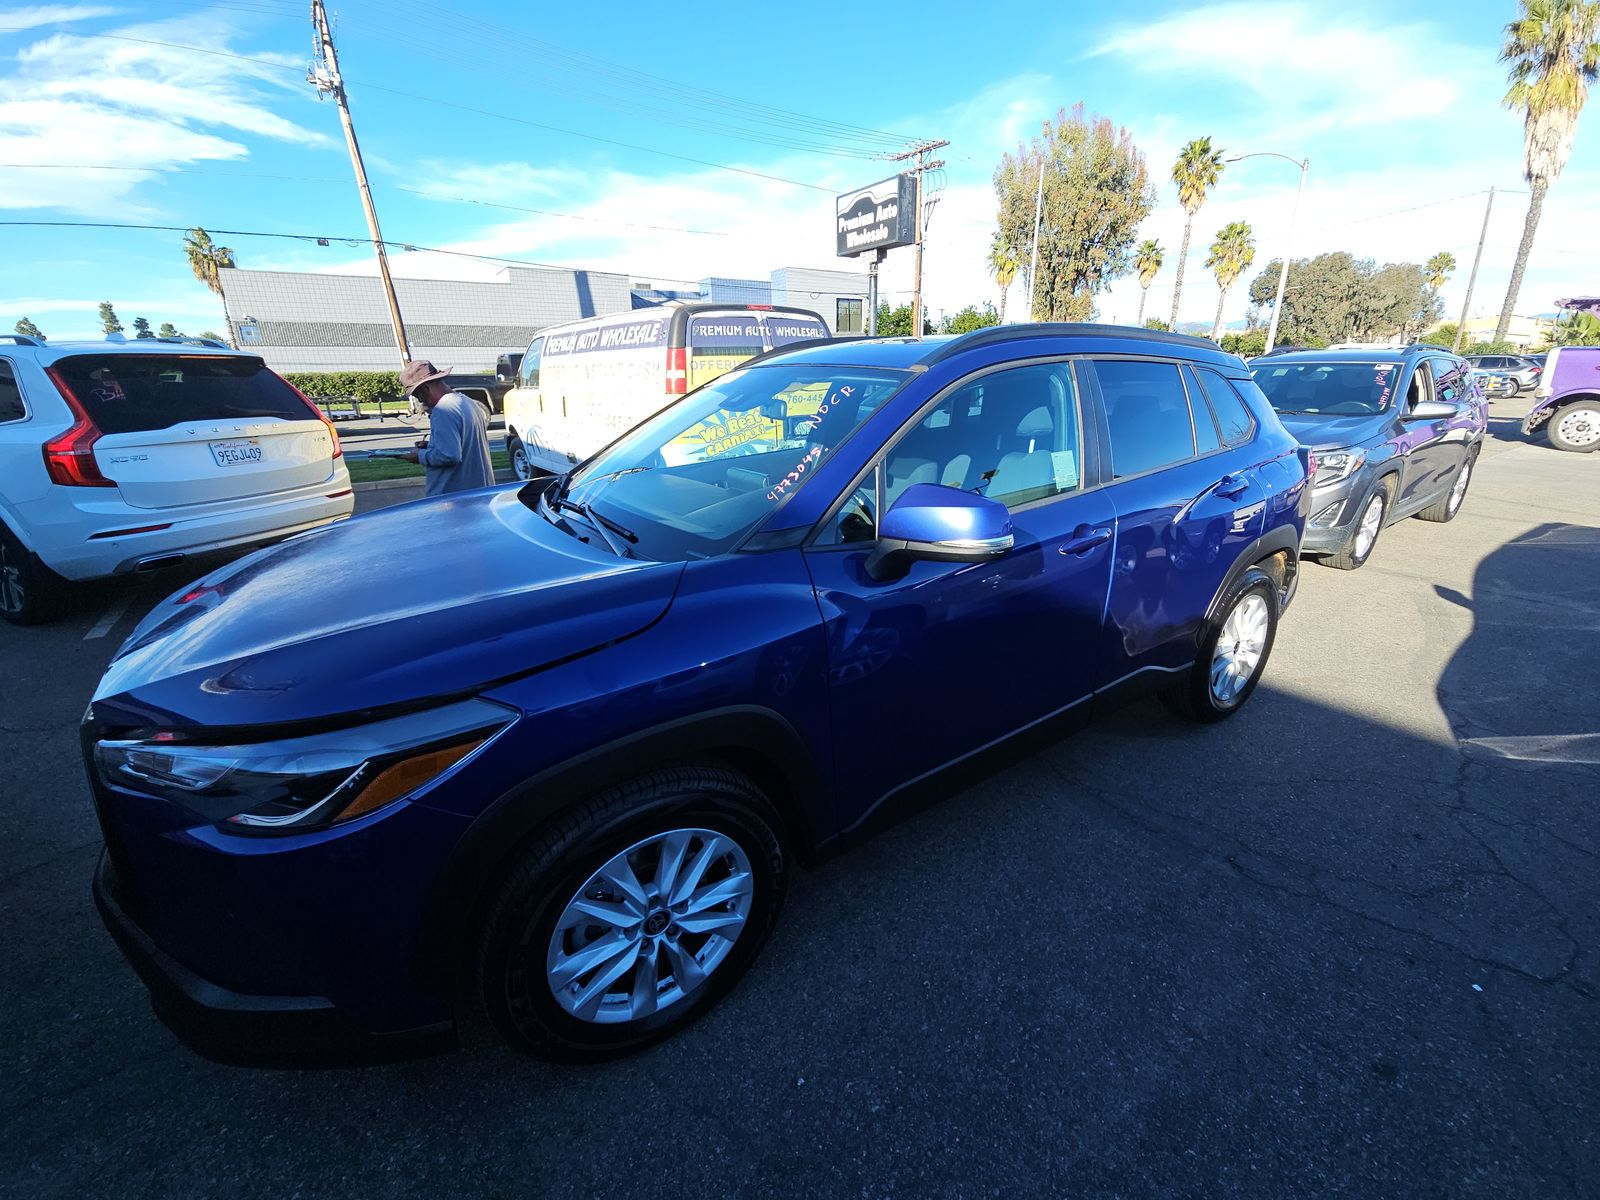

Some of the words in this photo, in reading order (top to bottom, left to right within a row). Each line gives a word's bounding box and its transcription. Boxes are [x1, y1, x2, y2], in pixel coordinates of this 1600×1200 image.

[838, 212, 875, 233] Premium
[875, 203, 898, 222] Auto
[846, 223, 889, 248] Wholesale
[576, 330, 598, 350] AUTO
[599, 323, 660, 348] WHOLESALE
[693, 325, 742, 337] PREMIUM
[745, 326, 771, 337] AUTO
[775, 326, 824, 338] WHOLESALE
[186, 422, 277, 435] VOLVO
[699, 424, 727, 443] We
[726, 408, 763, 434] Beat
[705, 424, 766, 457] CARMAX!
[217, 447, 262, 463] 9EGJ409
